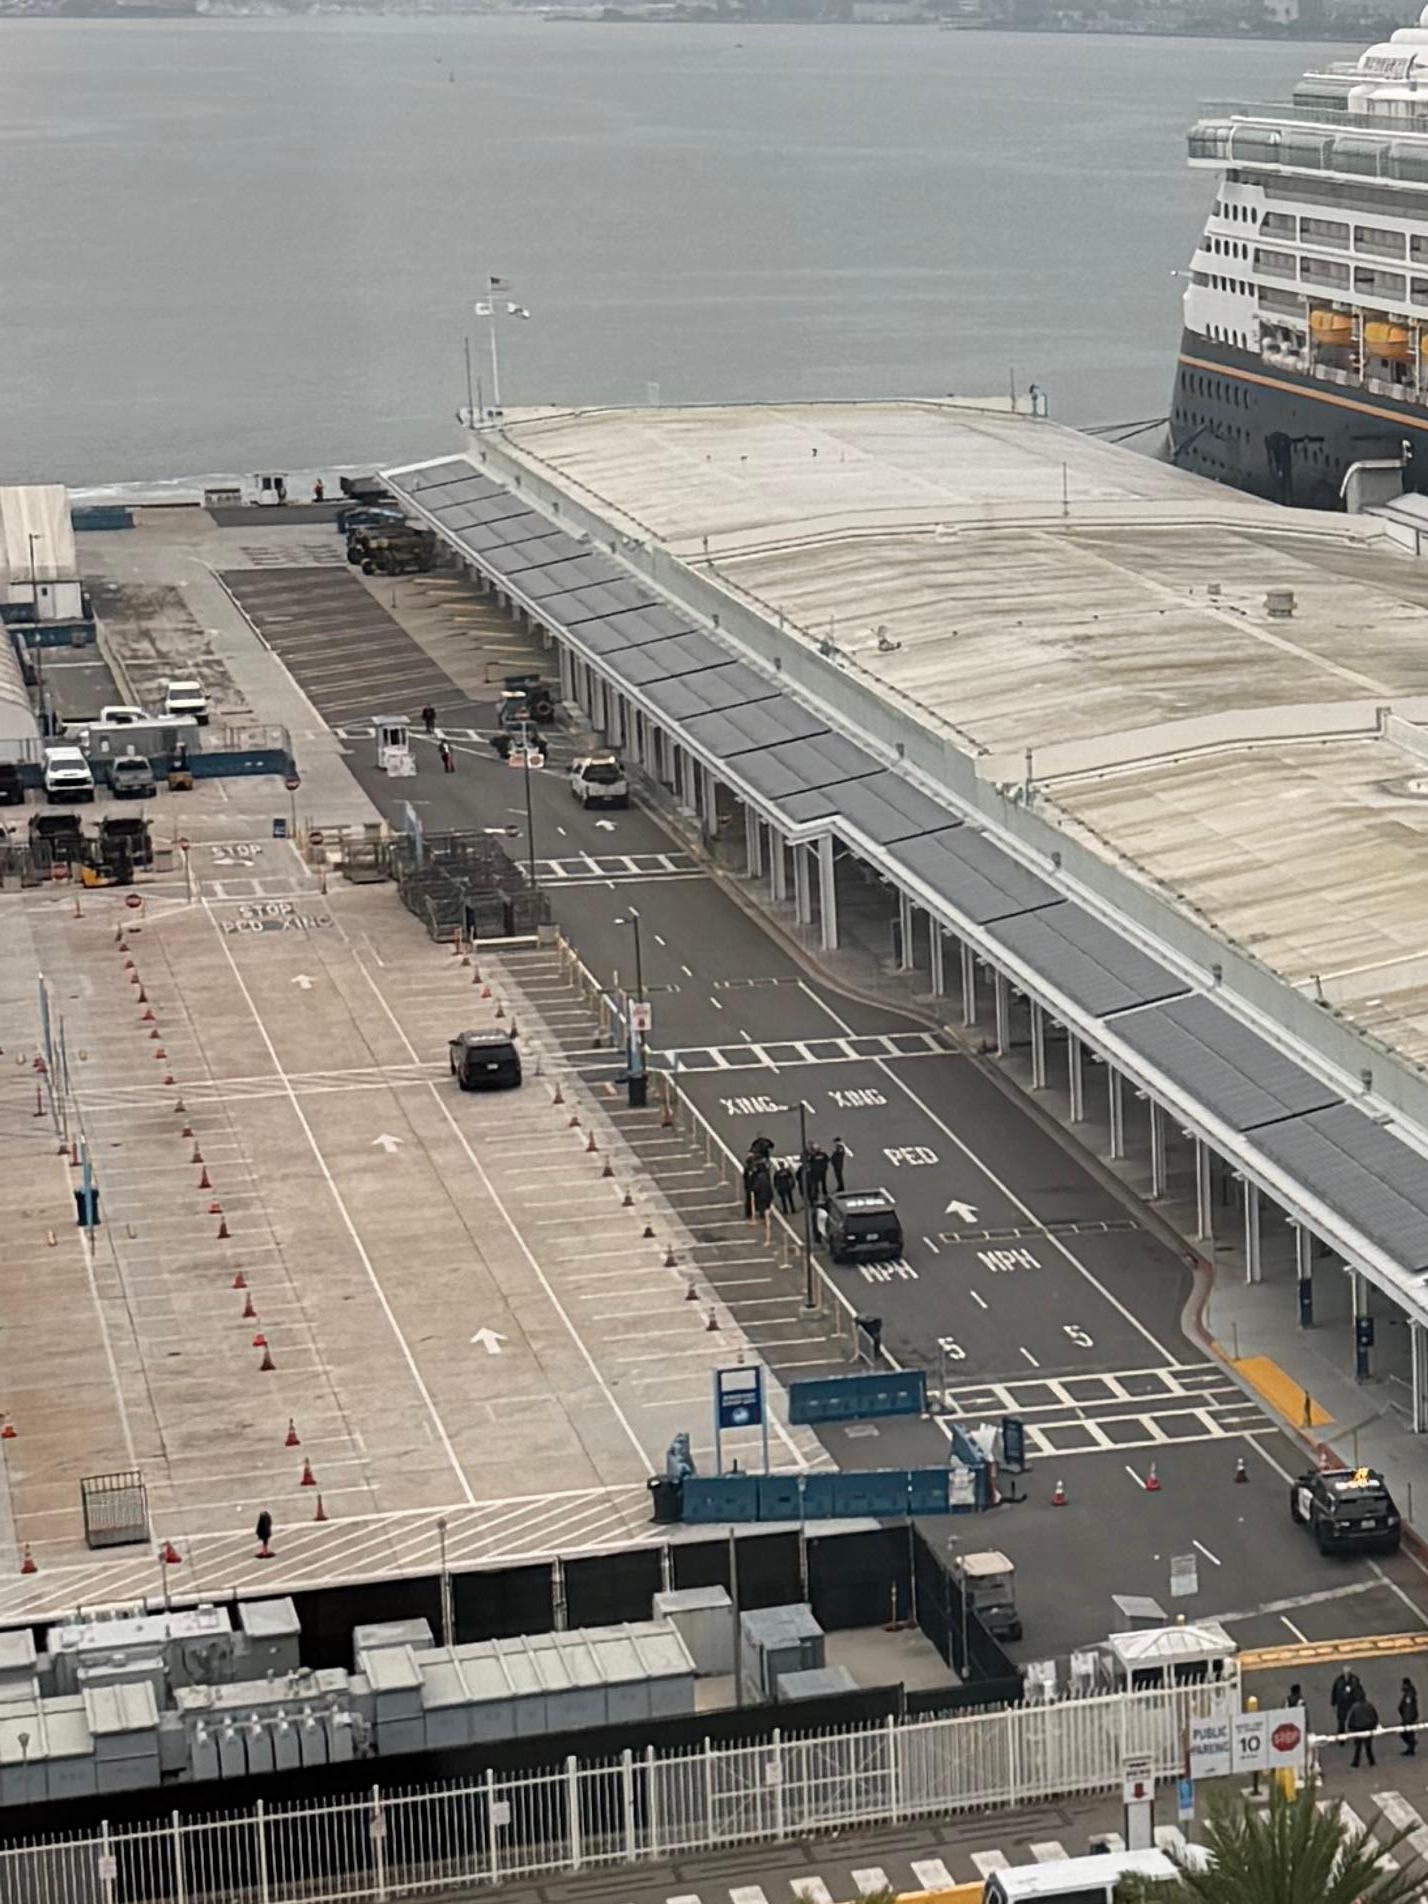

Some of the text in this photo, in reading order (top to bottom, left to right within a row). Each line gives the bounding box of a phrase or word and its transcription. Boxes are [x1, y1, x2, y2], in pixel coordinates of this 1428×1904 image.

[210, 844, 263, 857] STOP
[239, 902, 294, 919] STOP
[720, 1096, 778, 1115] XING
[828, 1088, 887, 1108] XING
[883, 1146, 939, 1166] PED
[977, 1248, 1042, 1273] MPH
[857, 1259, 919, 1283] MPH
[1063, 1324, 1094, 1348] 5
[937, 1336, 967, 1360] 5
[1240, 1735, 1261, 1753] 10
[1273, 1729, 1300, 1745] STOP
